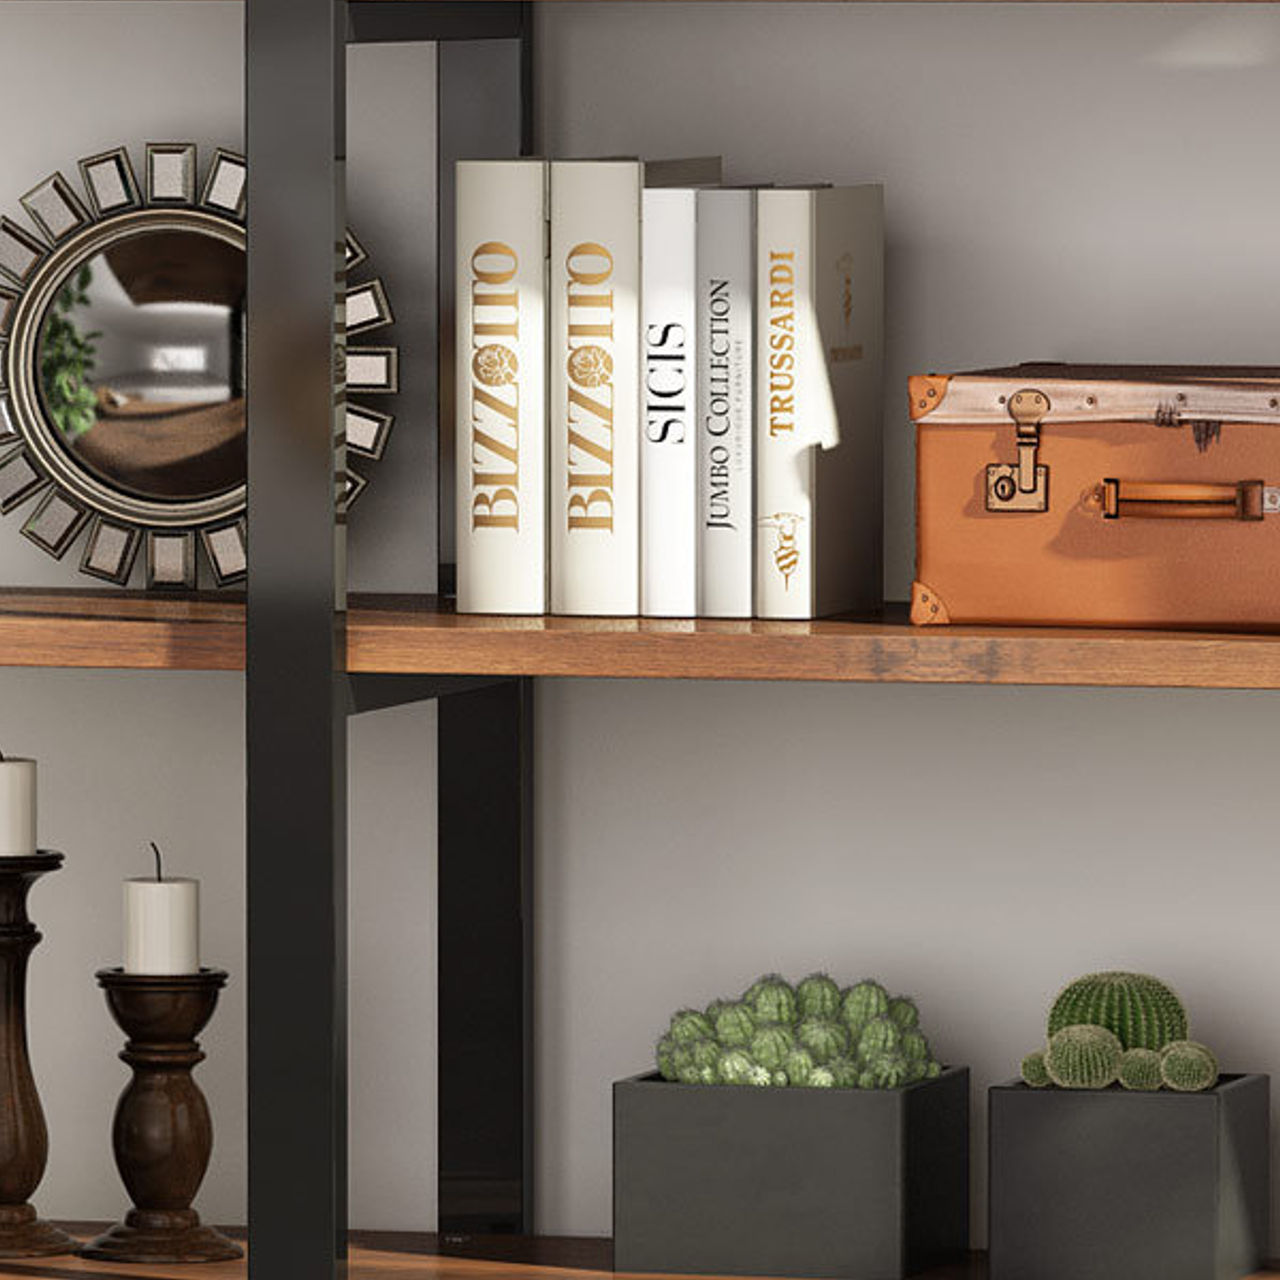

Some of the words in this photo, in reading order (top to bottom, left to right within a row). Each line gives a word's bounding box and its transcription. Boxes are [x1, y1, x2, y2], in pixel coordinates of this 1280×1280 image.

[646, 322, 687, 444] SICIS
[706, 278, 731, 437] COLLECTION
[768, 250, 795, 437] TRUSSARDI
[706, 445, 737, 532] JUMBO
